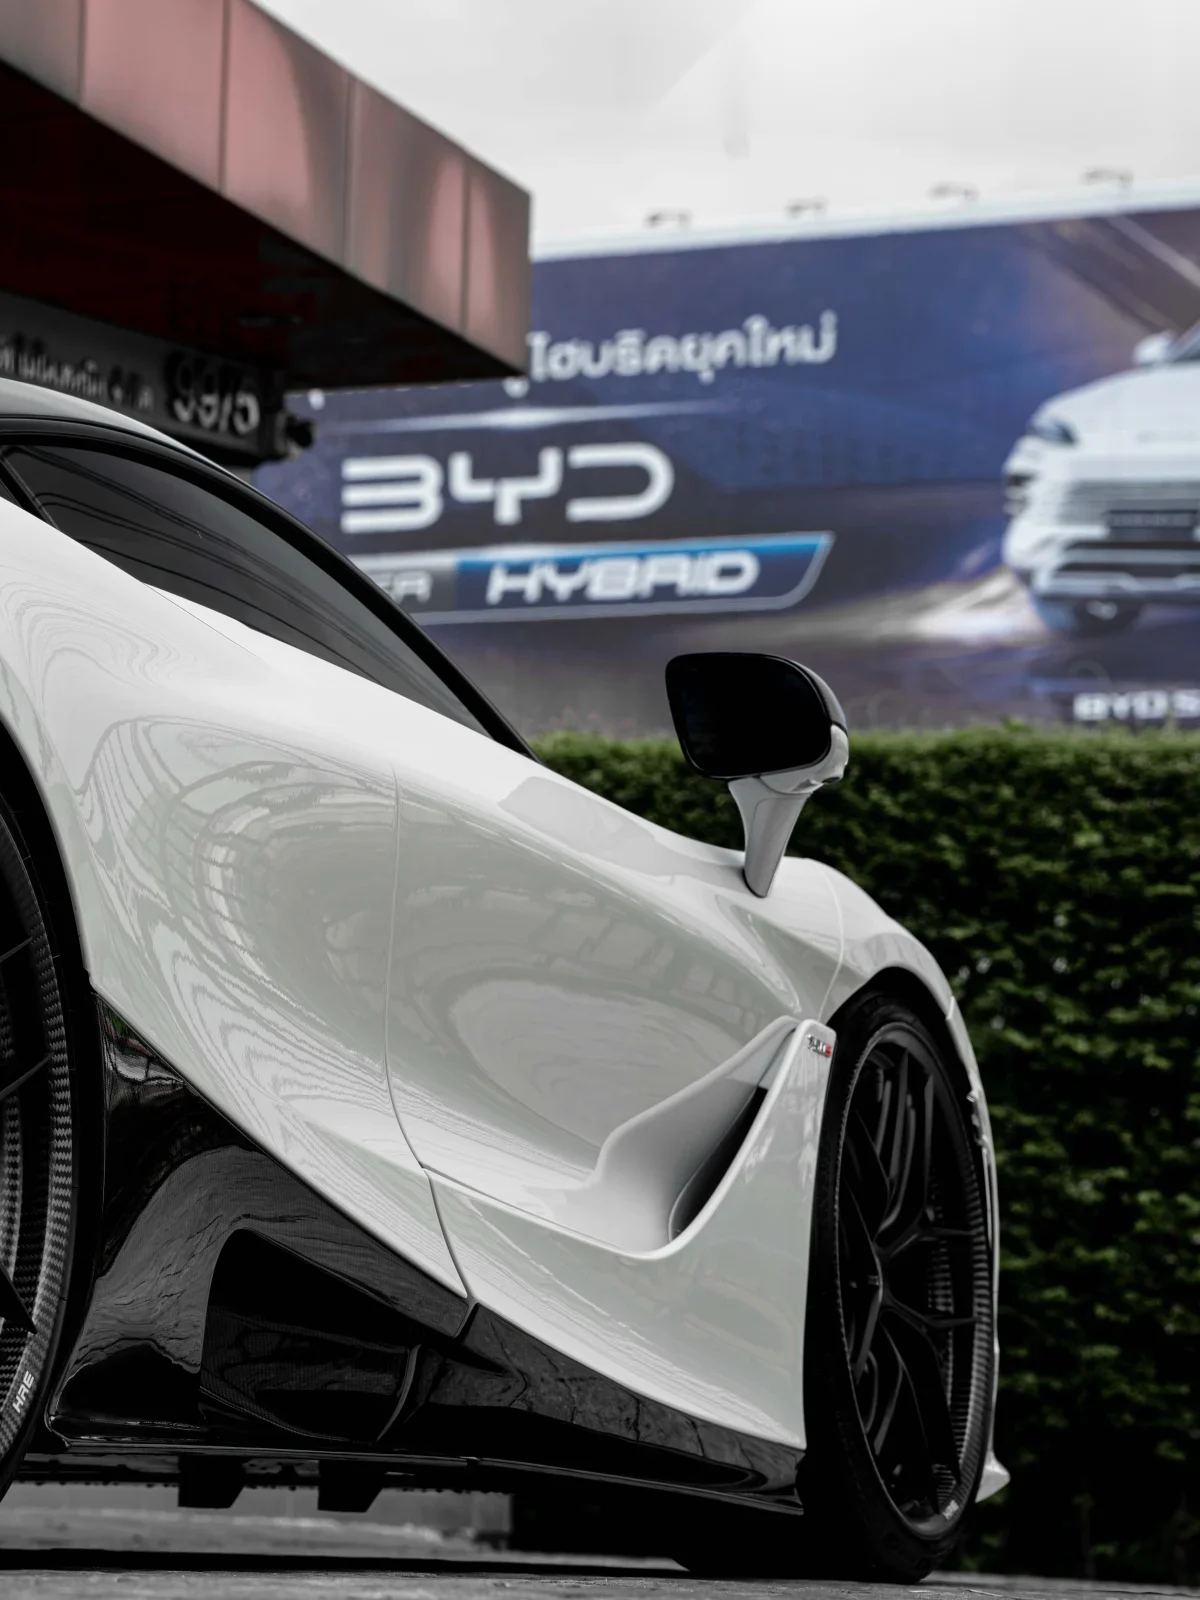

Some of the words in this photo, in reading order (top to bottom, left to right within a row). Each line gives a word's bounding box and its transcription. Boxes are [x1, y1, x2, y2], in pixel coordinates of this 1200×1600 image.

[340, 441, 676, 534] BYD
[485, 549, 761, 604] HYBRID
[12, 1370, 35, 1414] HRE
